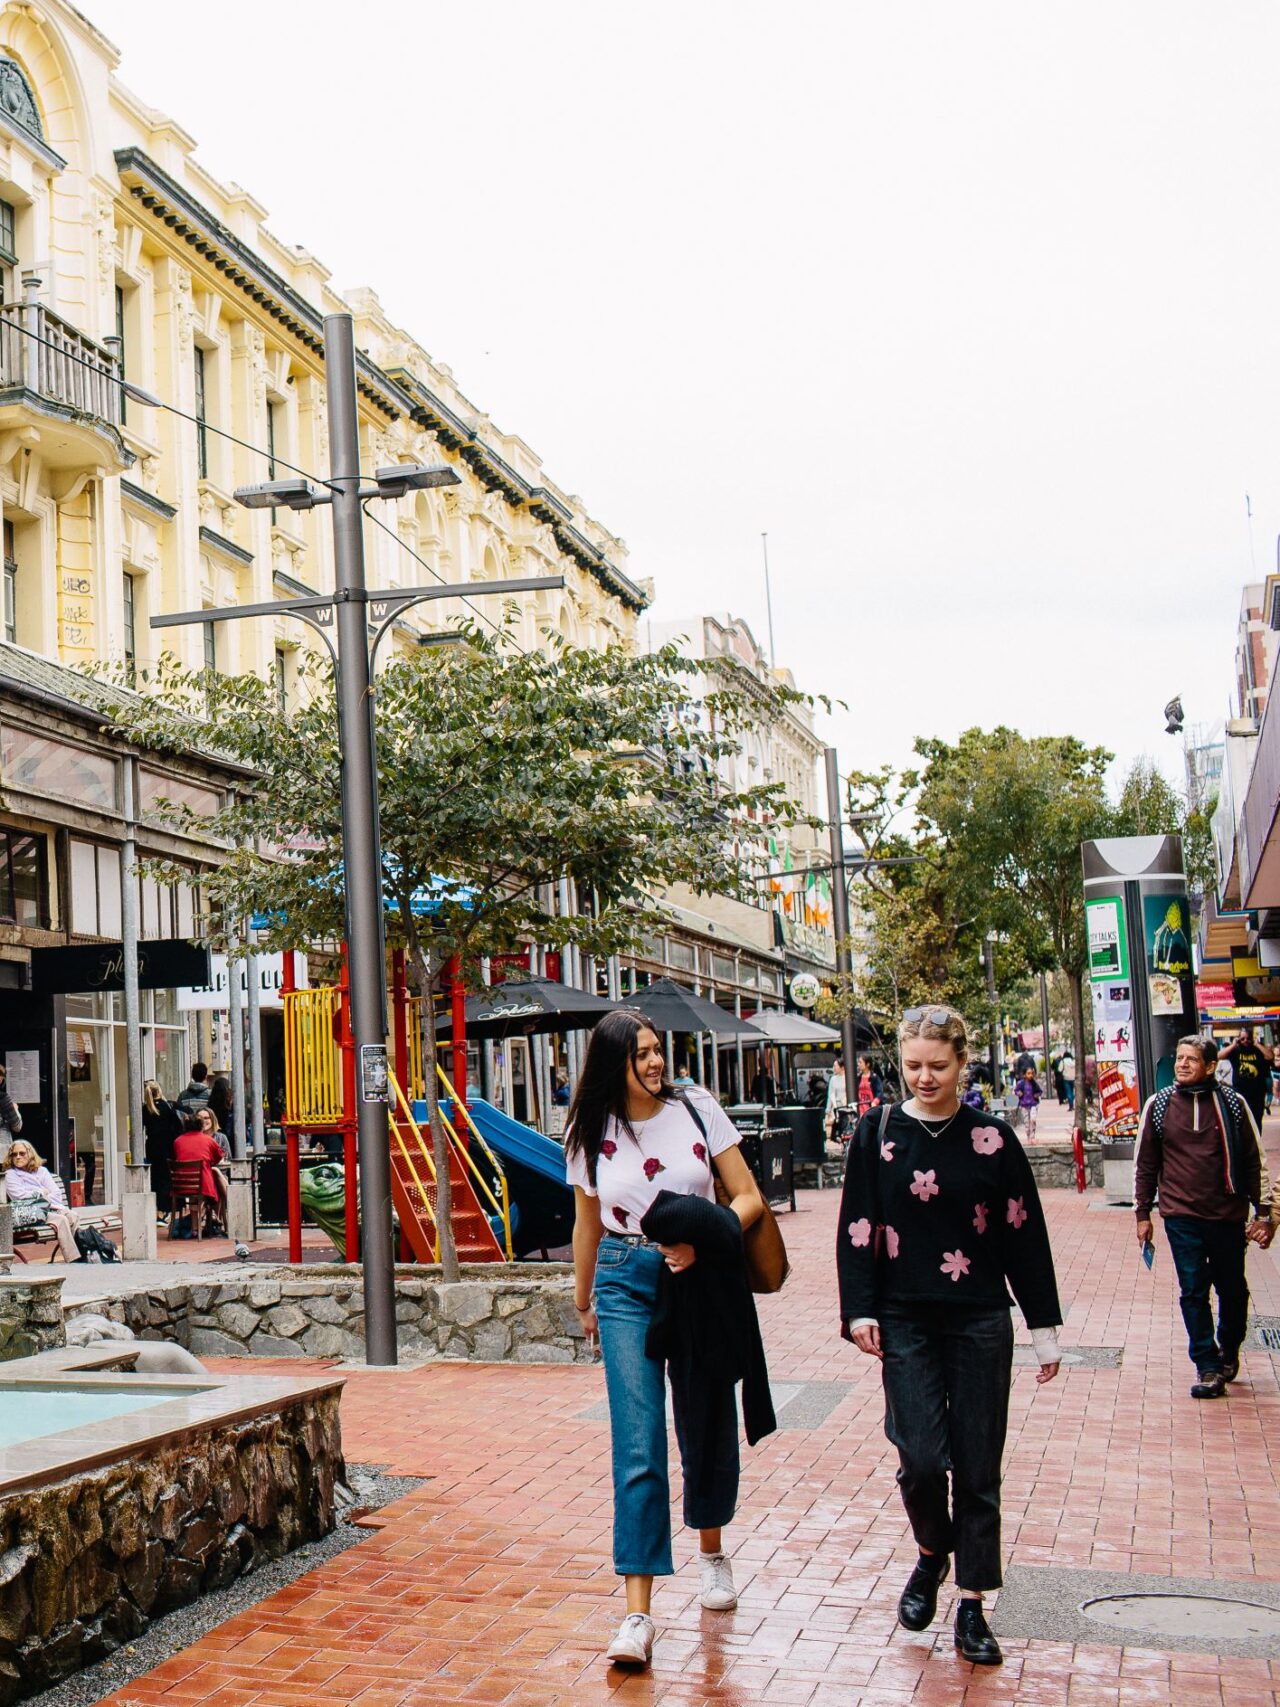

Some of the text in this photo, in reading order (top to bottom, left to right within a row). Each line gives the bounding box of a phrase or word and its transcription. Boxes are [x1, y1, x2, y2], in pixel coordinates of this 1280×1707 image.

[316, 608, 331, 622] W
[372, 603, 388, 616] W
[1098, 931, 1117, 942] TALKS
